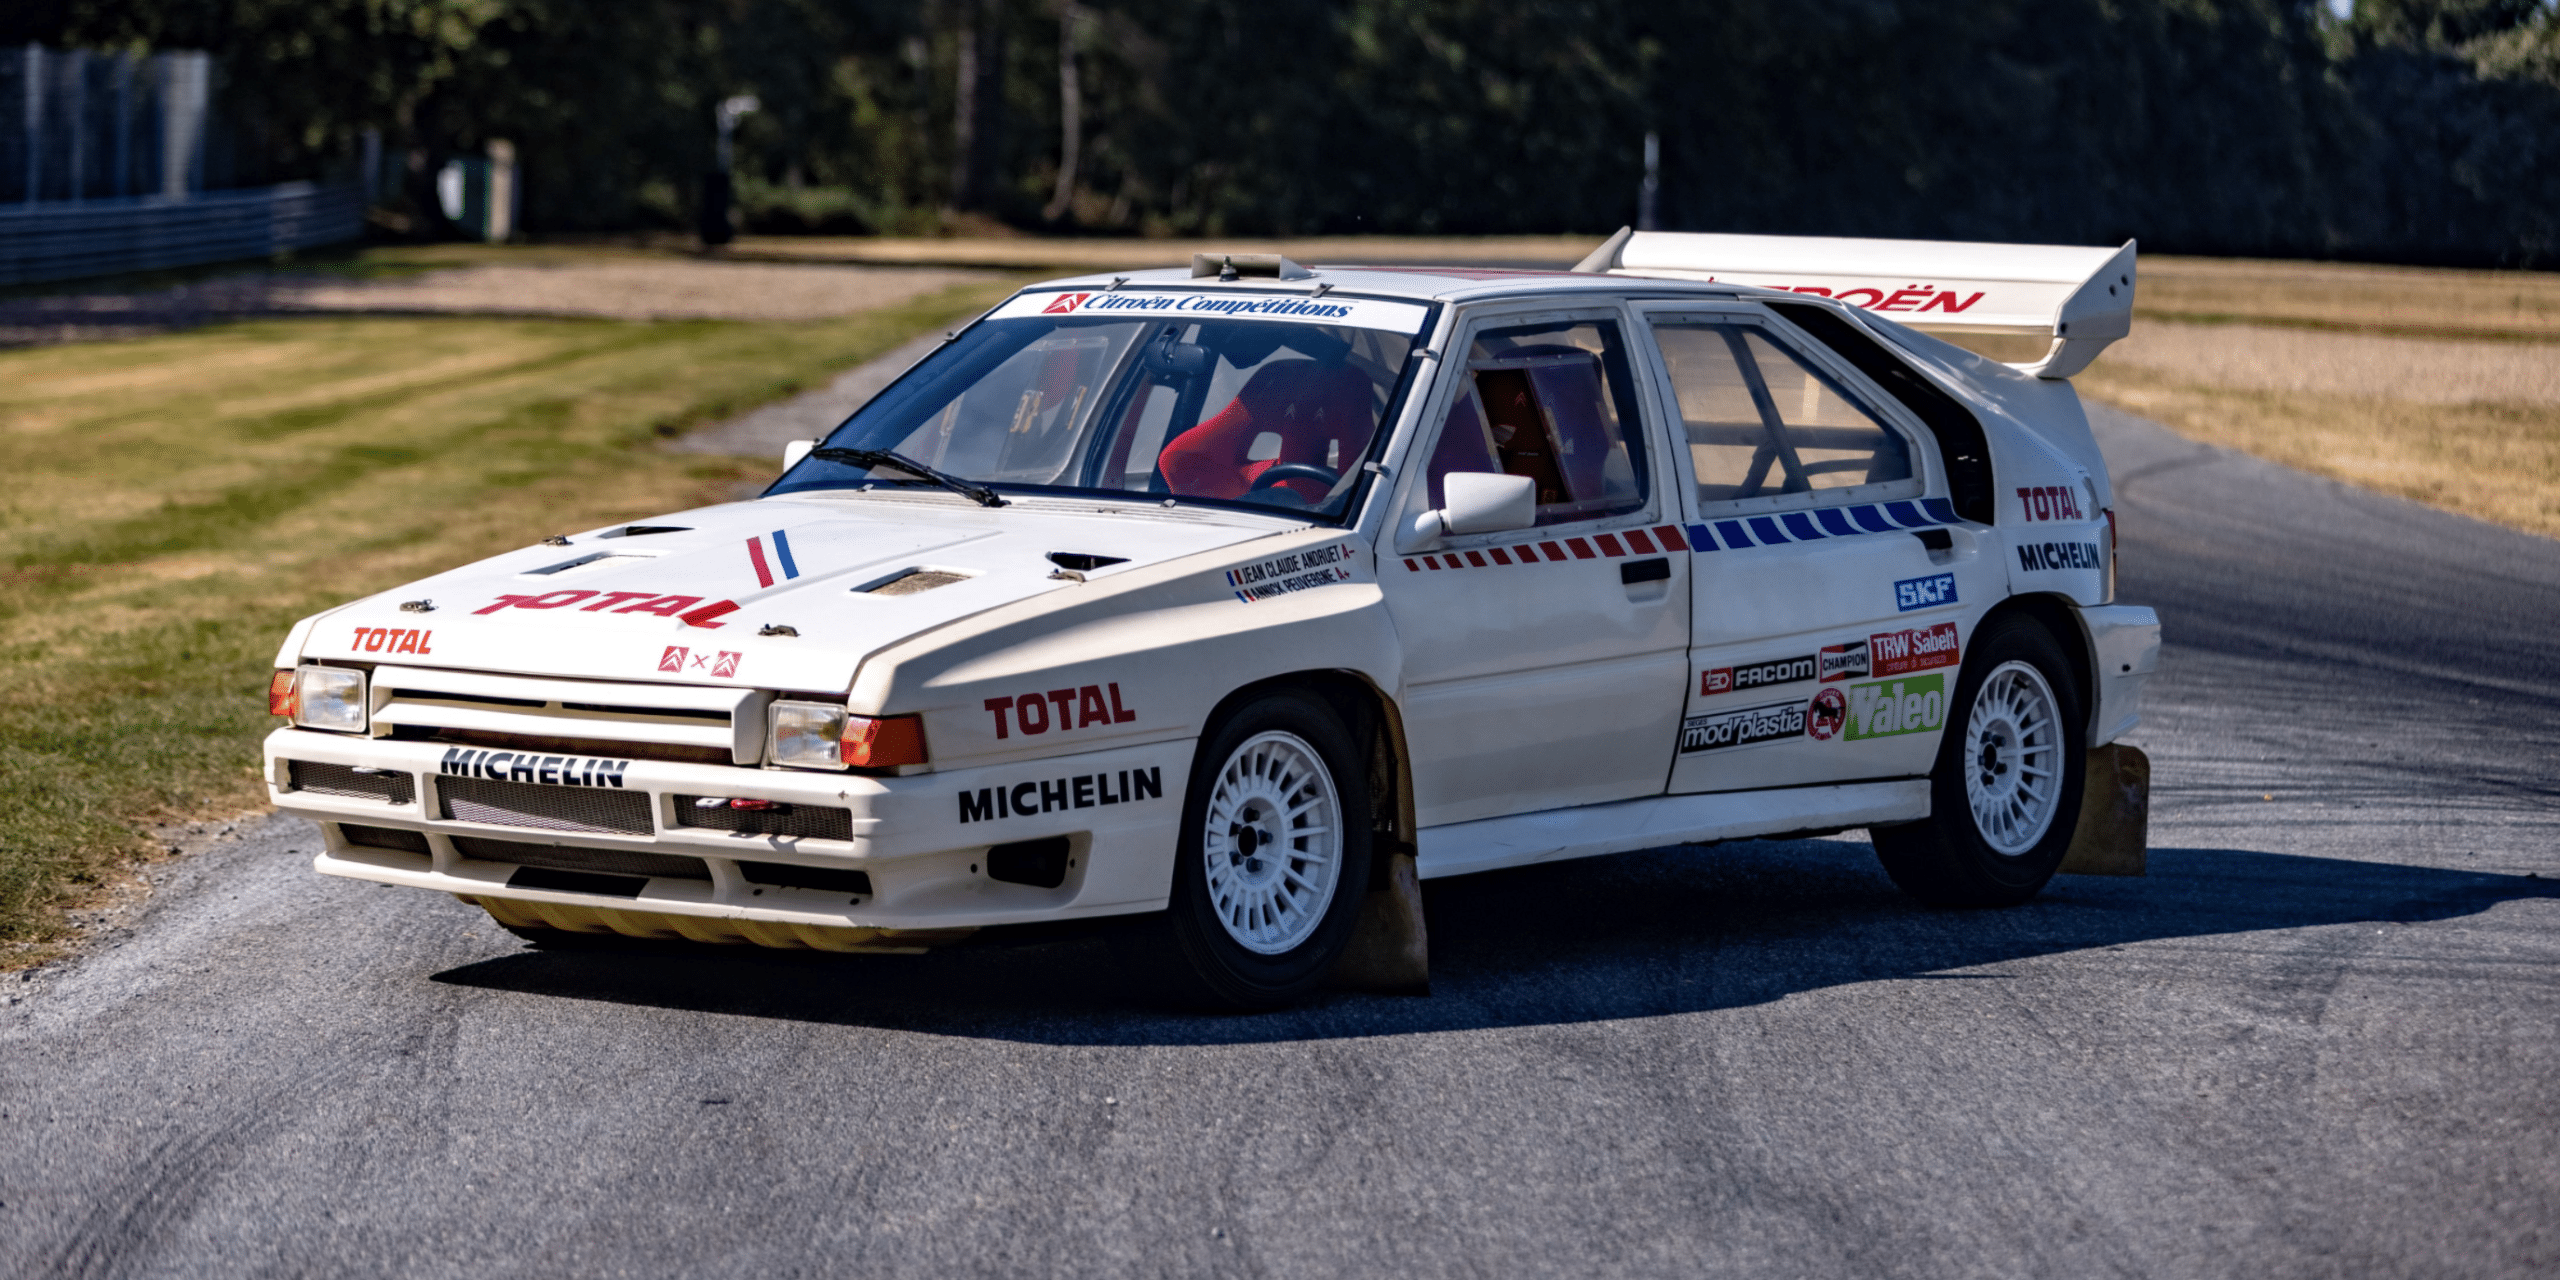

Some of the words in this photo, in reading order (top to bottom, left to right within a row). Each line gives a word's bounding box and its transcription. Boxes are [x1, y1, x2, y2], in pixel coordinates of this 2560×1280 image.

[1084, 294, 1173, 310] Citroën
[1176, 295, 1354, 318] Compétitions
[2016, 486, 2082, 522] TOTAL
[1242, 564, 1266, 584] JEAN
[1265, 555, 1301, 578] CLAUDE
[1301, 545, 1341, 569] ANDRUET
[2016, 542, 2101, 571] MICHELIN
[1250, 581, 1288, 600] ANNICK
[1899, 578, 1952, 607] SKF
[470, 589, 741, 629] TOTAL
[352, 627, 431, 654] TOTAL
[1874, 634, 1909, 661] TRW
[1912, 627, 1957, 655] Sabelt
[1735, 660, 1813, 686] FACOM
[1822, 653, 1867, 671] CHAMPION
[984, 682, 1136, 739] TOTAL
[1850, 682, 1941, 735] Valeo
[441, 748, 629, 787] MICHELIN
[958, 766, 1162, 823] MICHELIN
